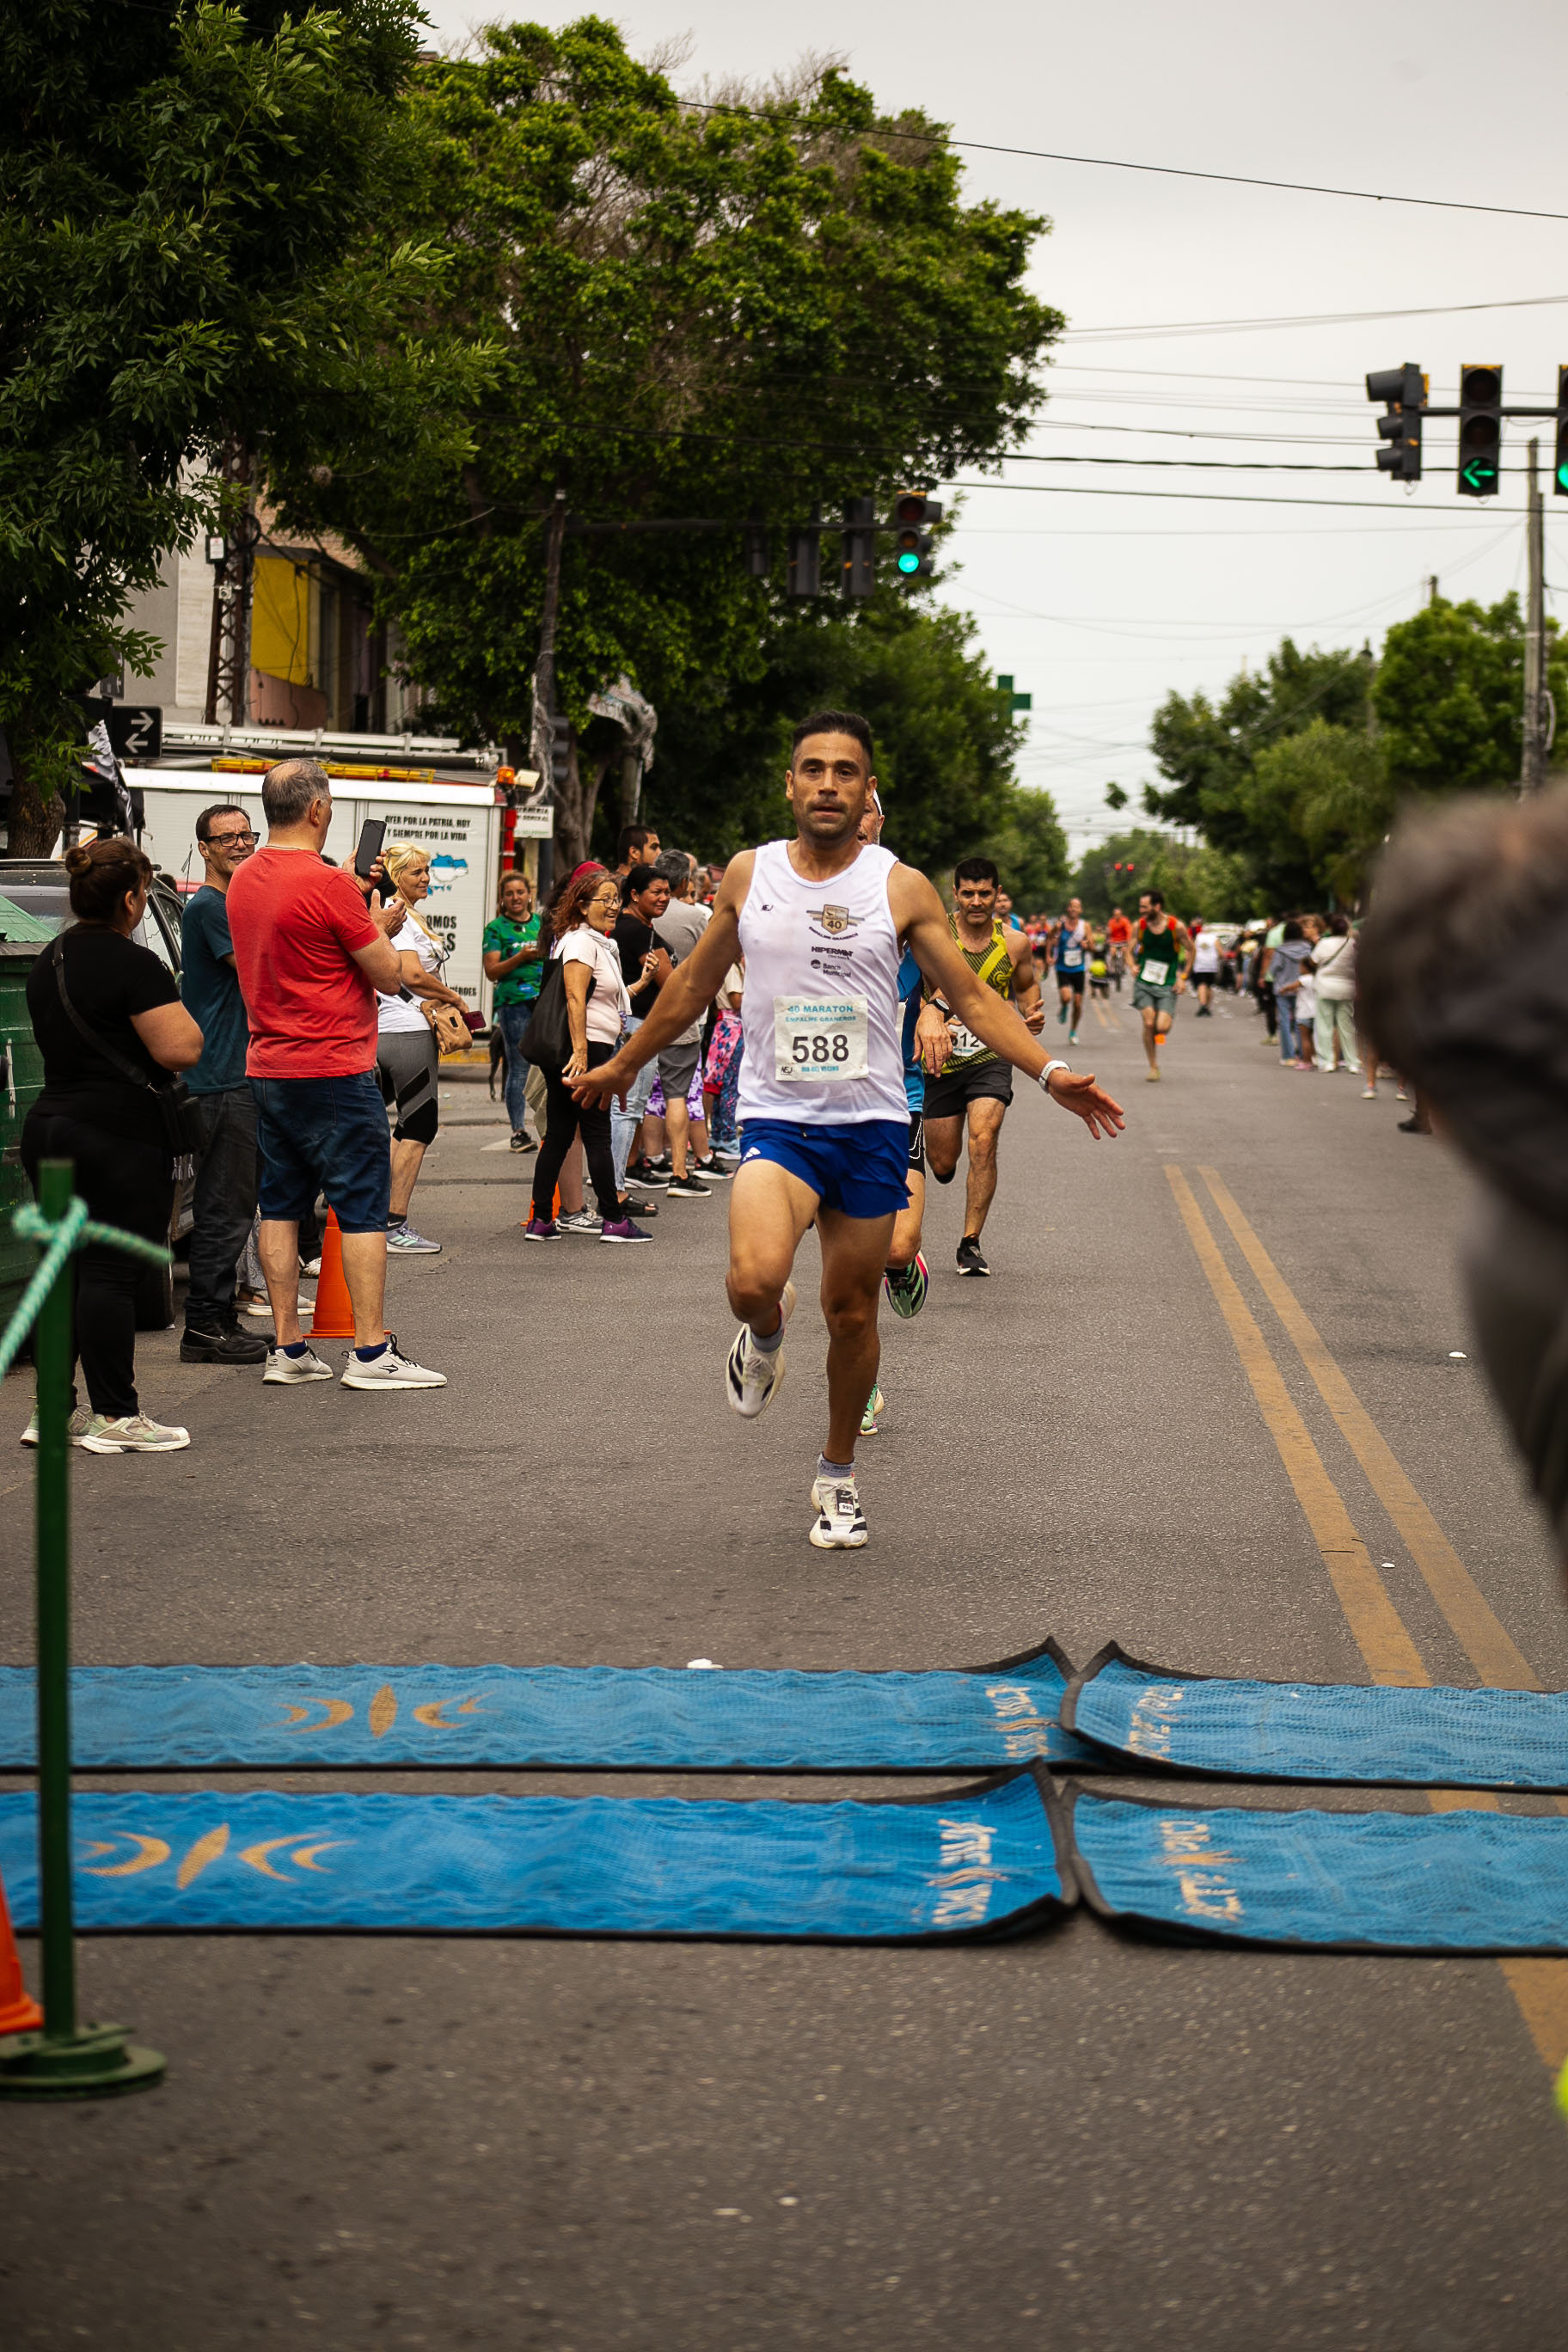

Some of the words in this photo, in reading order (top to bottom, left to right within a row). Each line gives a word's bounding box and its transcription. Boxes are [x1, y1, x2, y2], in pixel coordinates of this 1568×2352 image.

[385, 815, 401, 824] AYER
[403, 816, 418, 825] POR
[420, 818, 427, 826] LA
[456, 819, 471, 828] HOY
[387, 829, 391, 838] Y
[393, 830, 423, 839] SIEMPRE
[425, 830, 439, 840] POR
[441, 832, 449, 841] LA
[450, 832, 468, 842] VIDA
[426, 915, 456, 928] OMOS
[827, 920, 842, 929] 40
[793, 1035, 848, 1063] 588
